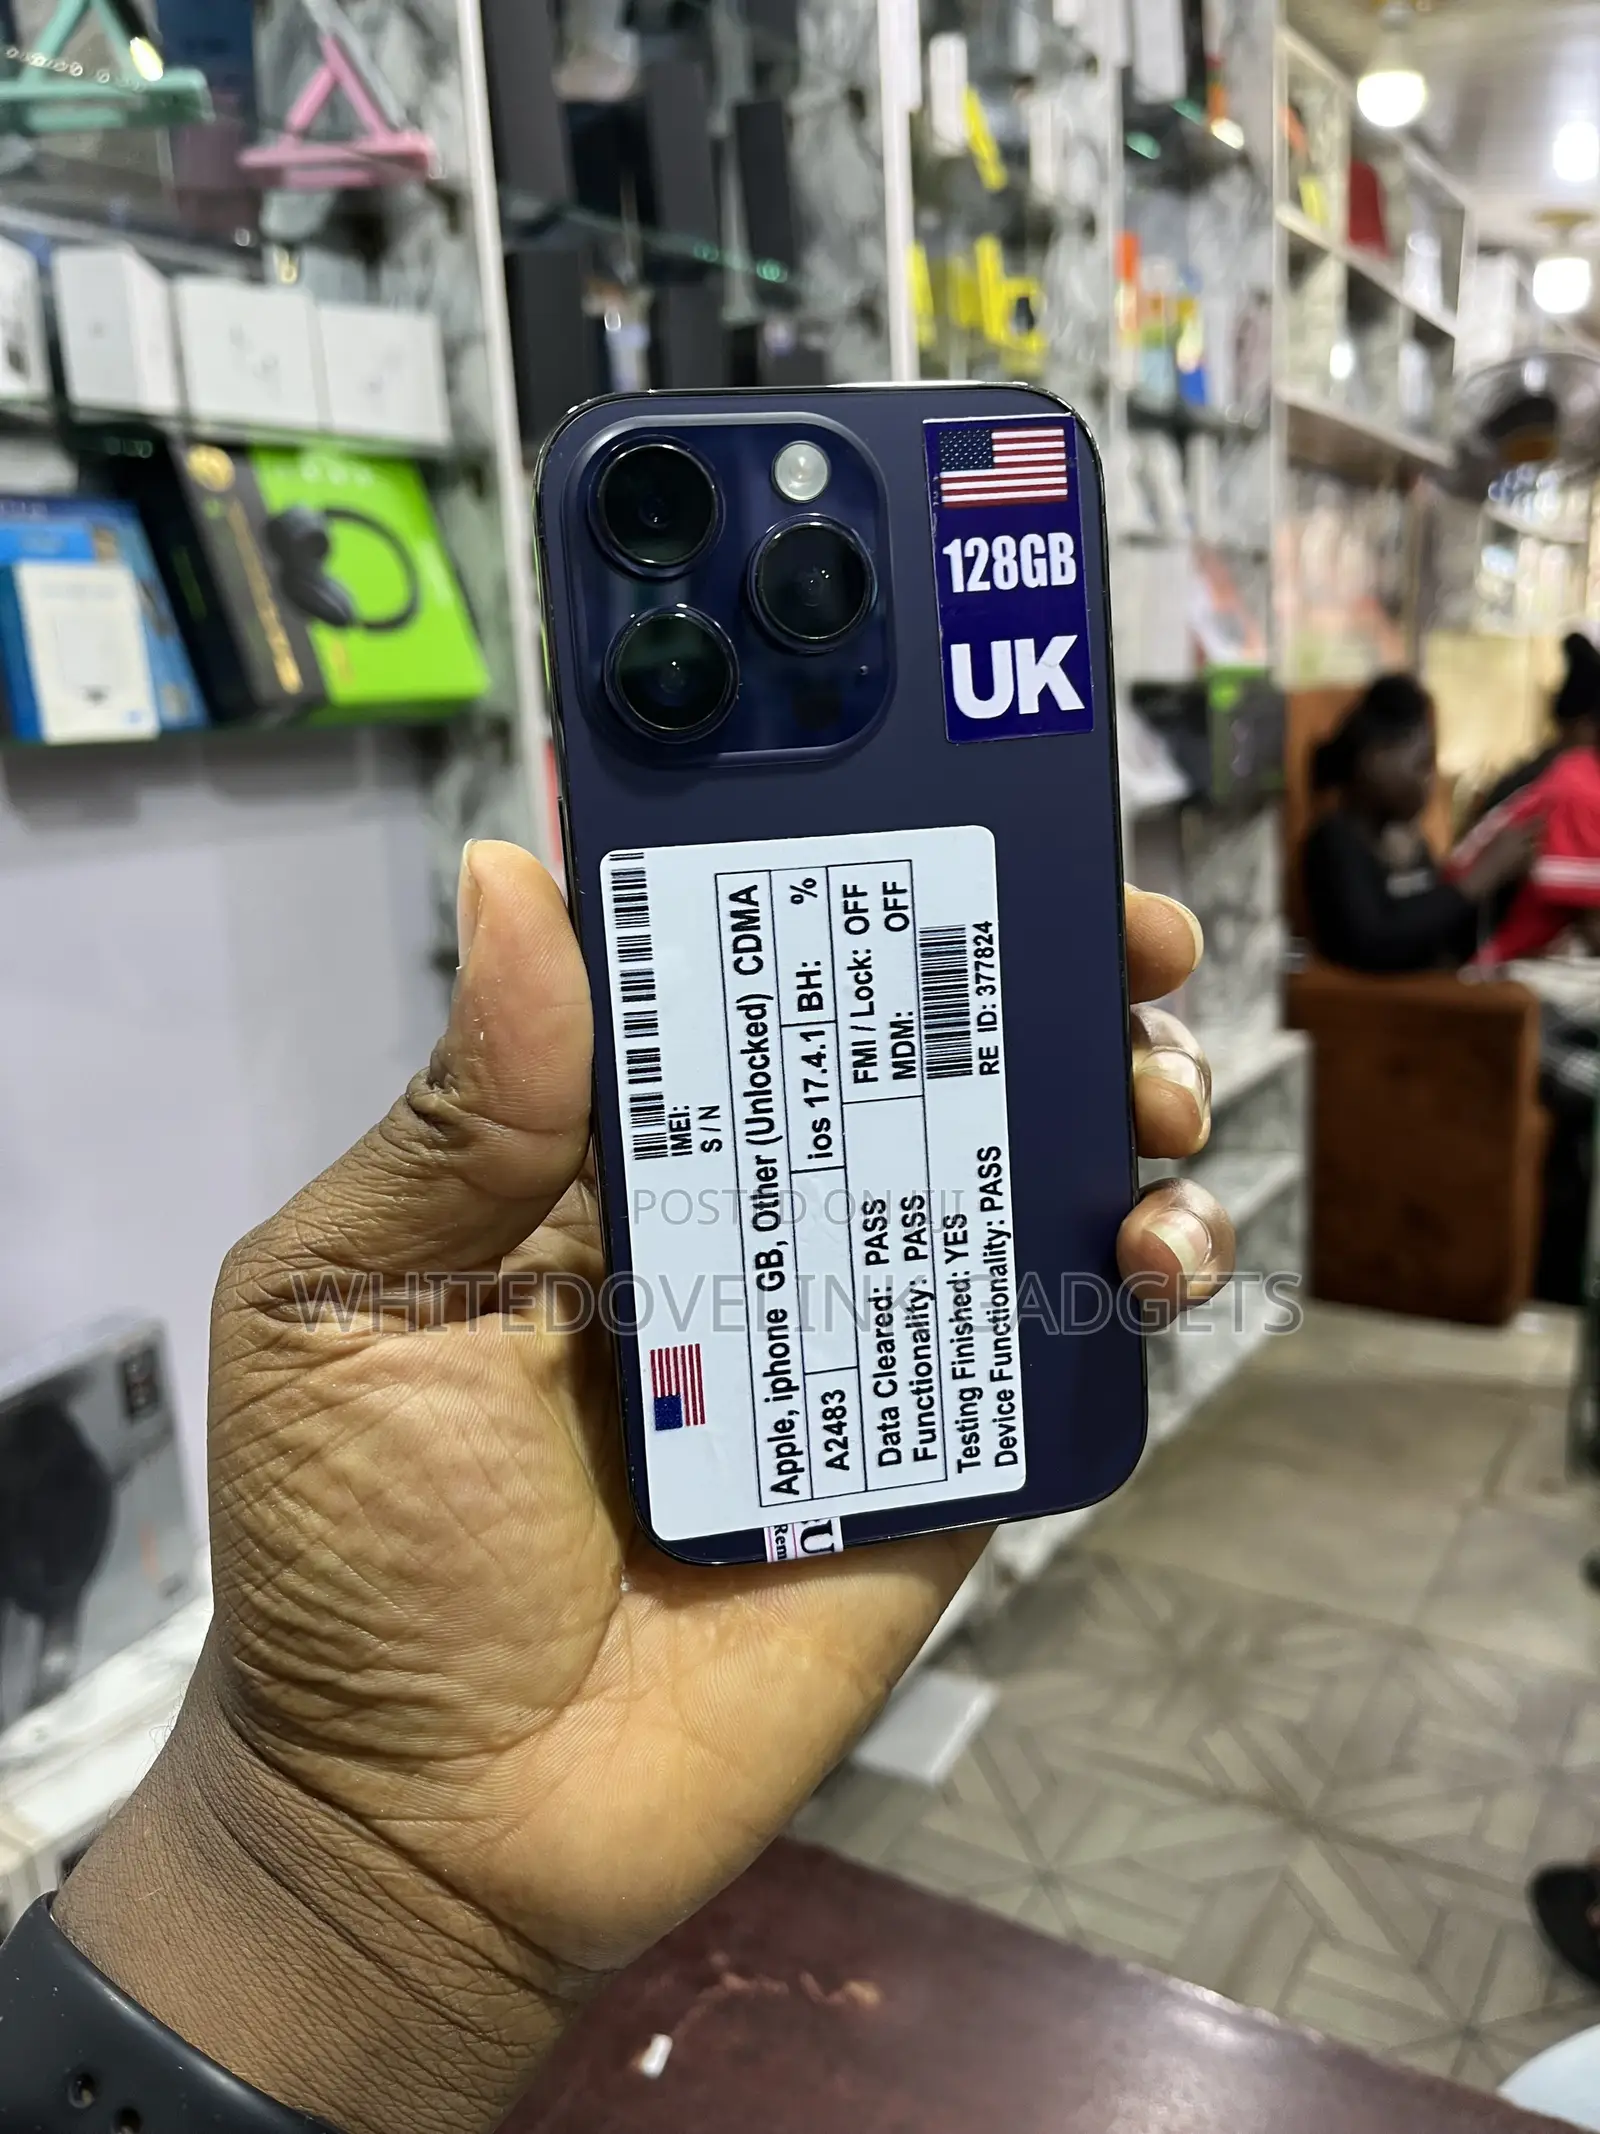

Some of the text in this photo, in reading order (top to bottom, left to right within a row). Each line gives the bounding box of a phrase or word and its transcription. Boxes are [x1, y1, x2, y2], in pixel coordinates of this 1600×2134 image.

[942, 532, 1077, 593] 128GB
[950, 634, 1086, 719] UK
[790, 877, 824, 1012] BH: %
[842, 883, 870, 935] OFF
[847, 948, 875, 1017] Lock:
[882, 881, 917, 1081] MDM: OFF
[972, 921, 1000, 1076] RE ID: 377824
[800, 1030, 833, 1159] ios 17.4.1
[851, 1039, 879, 1084] FMI
[669, 1105, 693, 1157] IMEI:
[729, 884, 805, 1496] Apple, iphone GB, Other (Unlocked) CDMA
[861, 1198, 901, 1467] Data Cleared: PASS
[900, 1194, 938, 1462] Functionality: PASS
[942, 1213, 983, 1474] Testing Finished: YES
[977, 1145, 1019, 1468] Device Functionality: PASS
[821, 1388, 850, 1472] A2483
